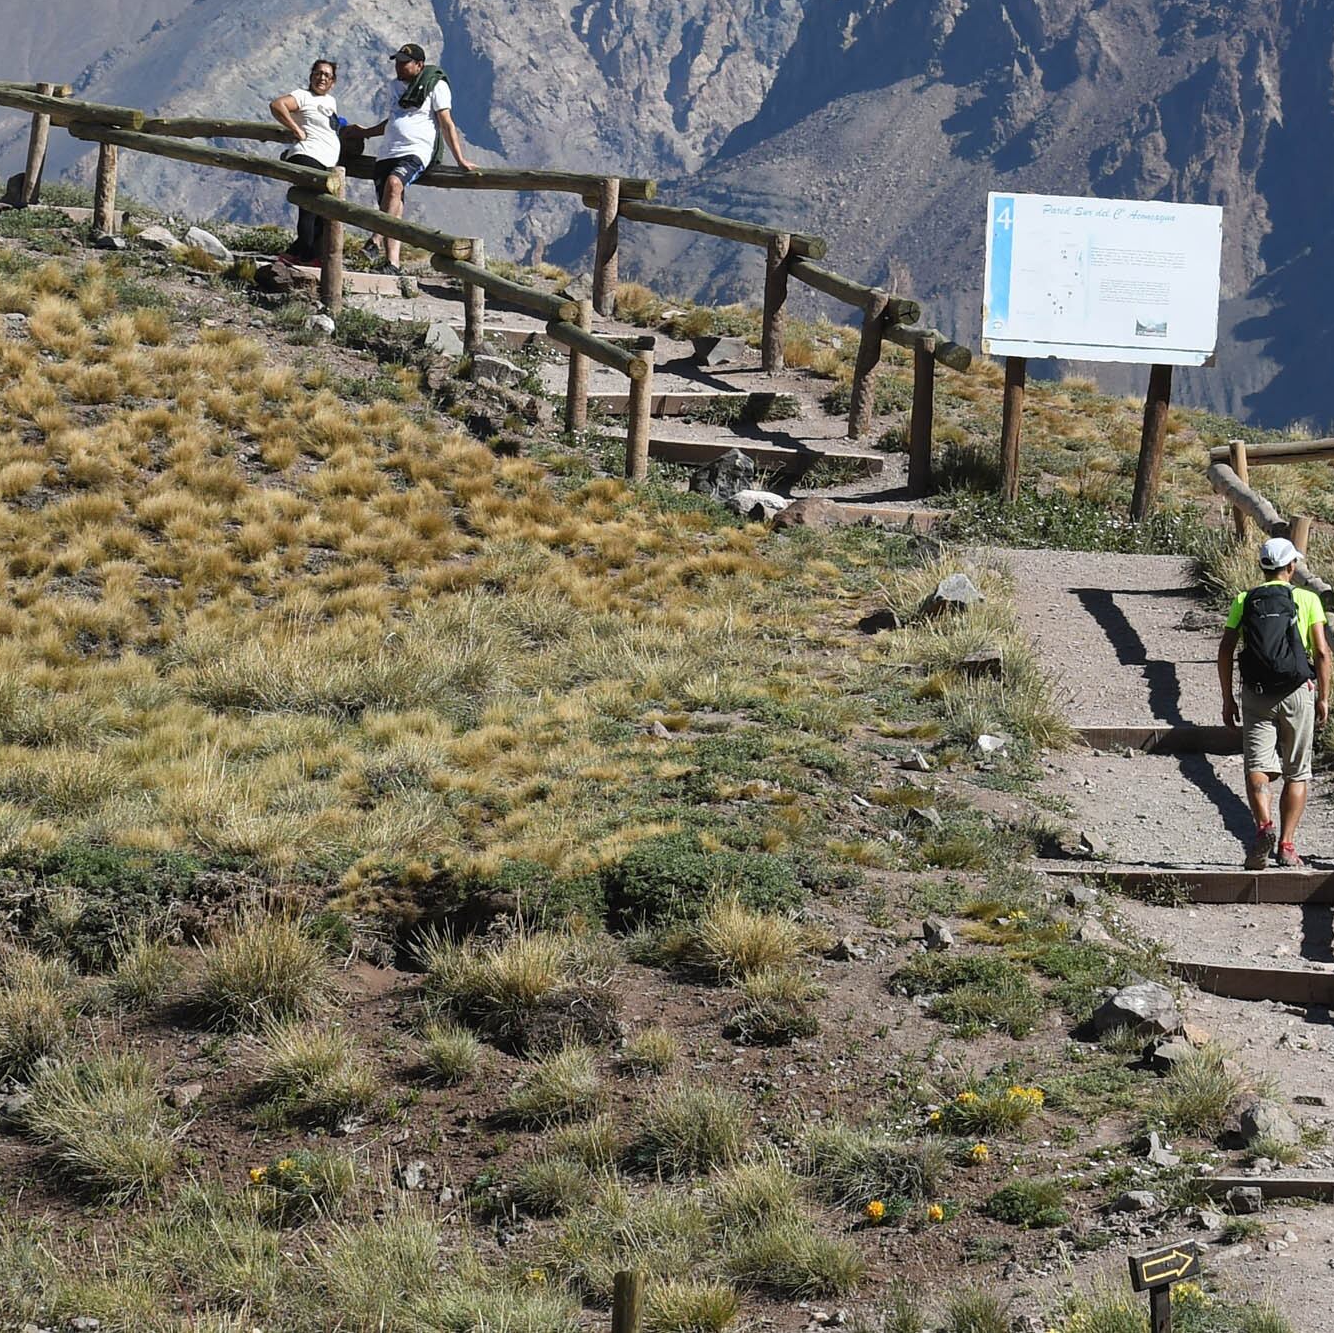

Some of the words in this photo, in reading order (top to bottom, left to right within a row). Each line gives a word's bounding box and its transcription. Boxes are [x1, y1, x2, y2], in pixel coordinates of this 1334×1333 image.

[996, 206, 1013, 230] 4
[1074, 207, 1092, 216] Sur
[1095, 208, 1110, 217] del
